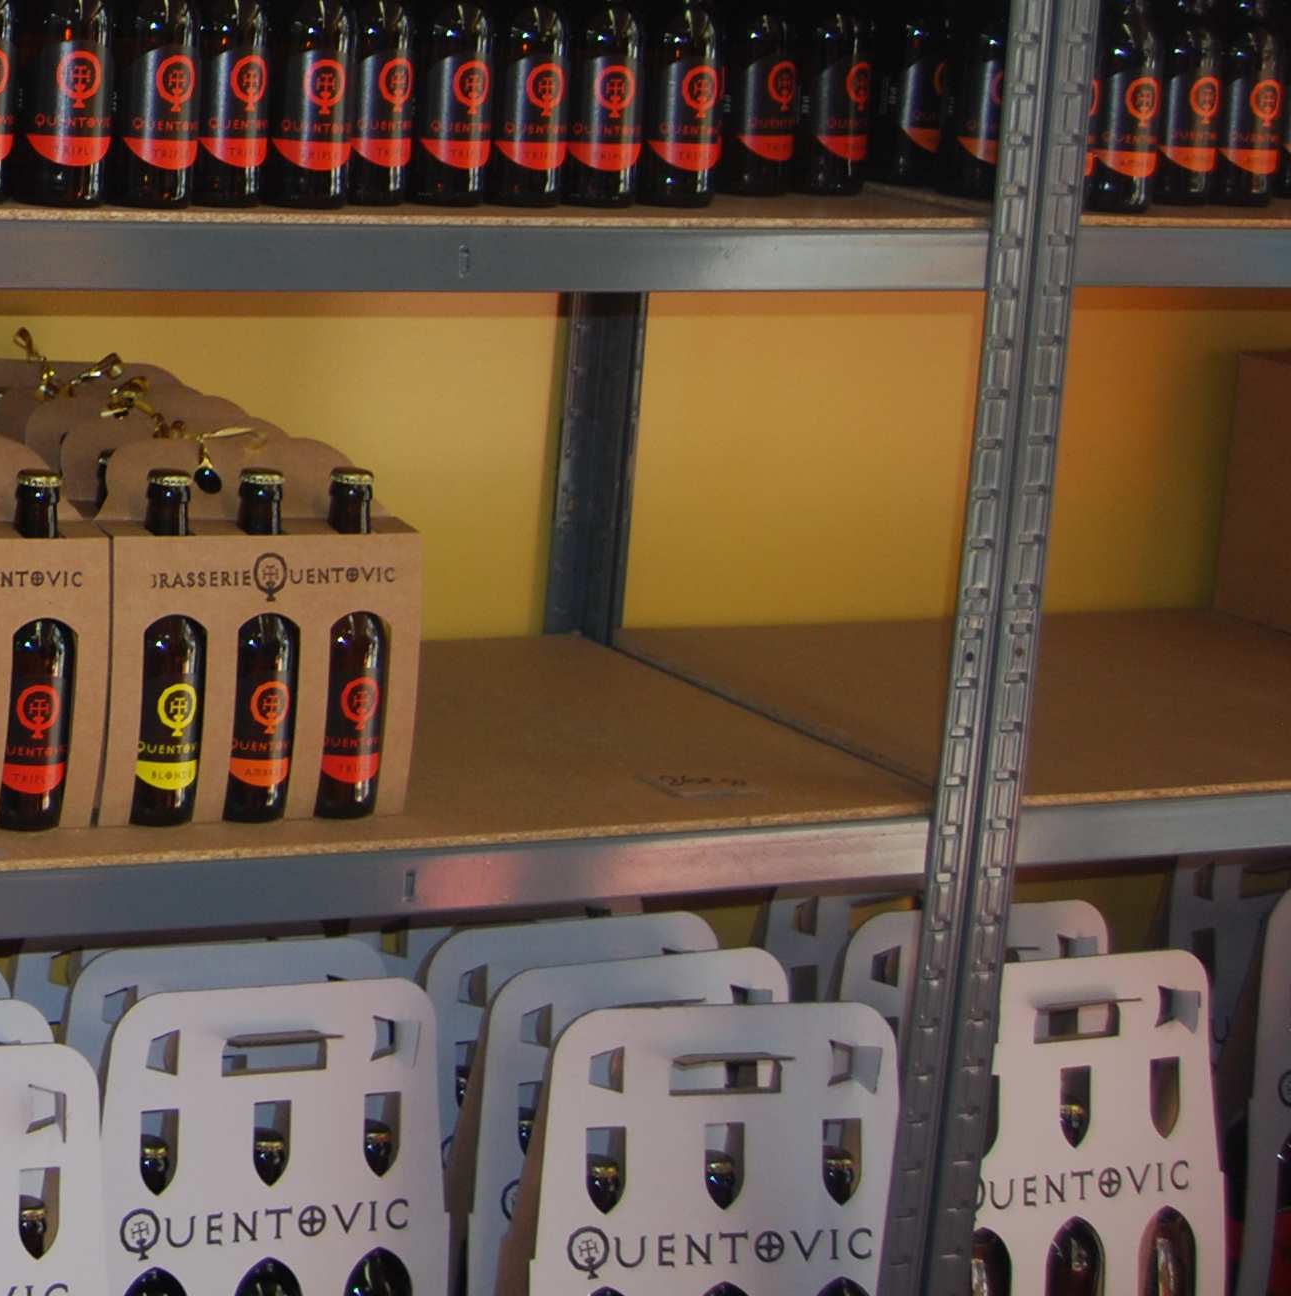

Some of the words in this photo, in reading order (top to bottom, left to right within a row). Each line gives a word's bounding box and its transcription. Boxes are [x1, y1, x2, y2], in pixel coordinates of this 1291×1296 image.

[253, 552, 396, 602] QUENTOVIC
[976, 1160, 1190, 1211] UENTOVIC
[120, 1198, 410, 1261] QUENTOVIC
[567, 1226, 873, 1280] QUENTOVIC
